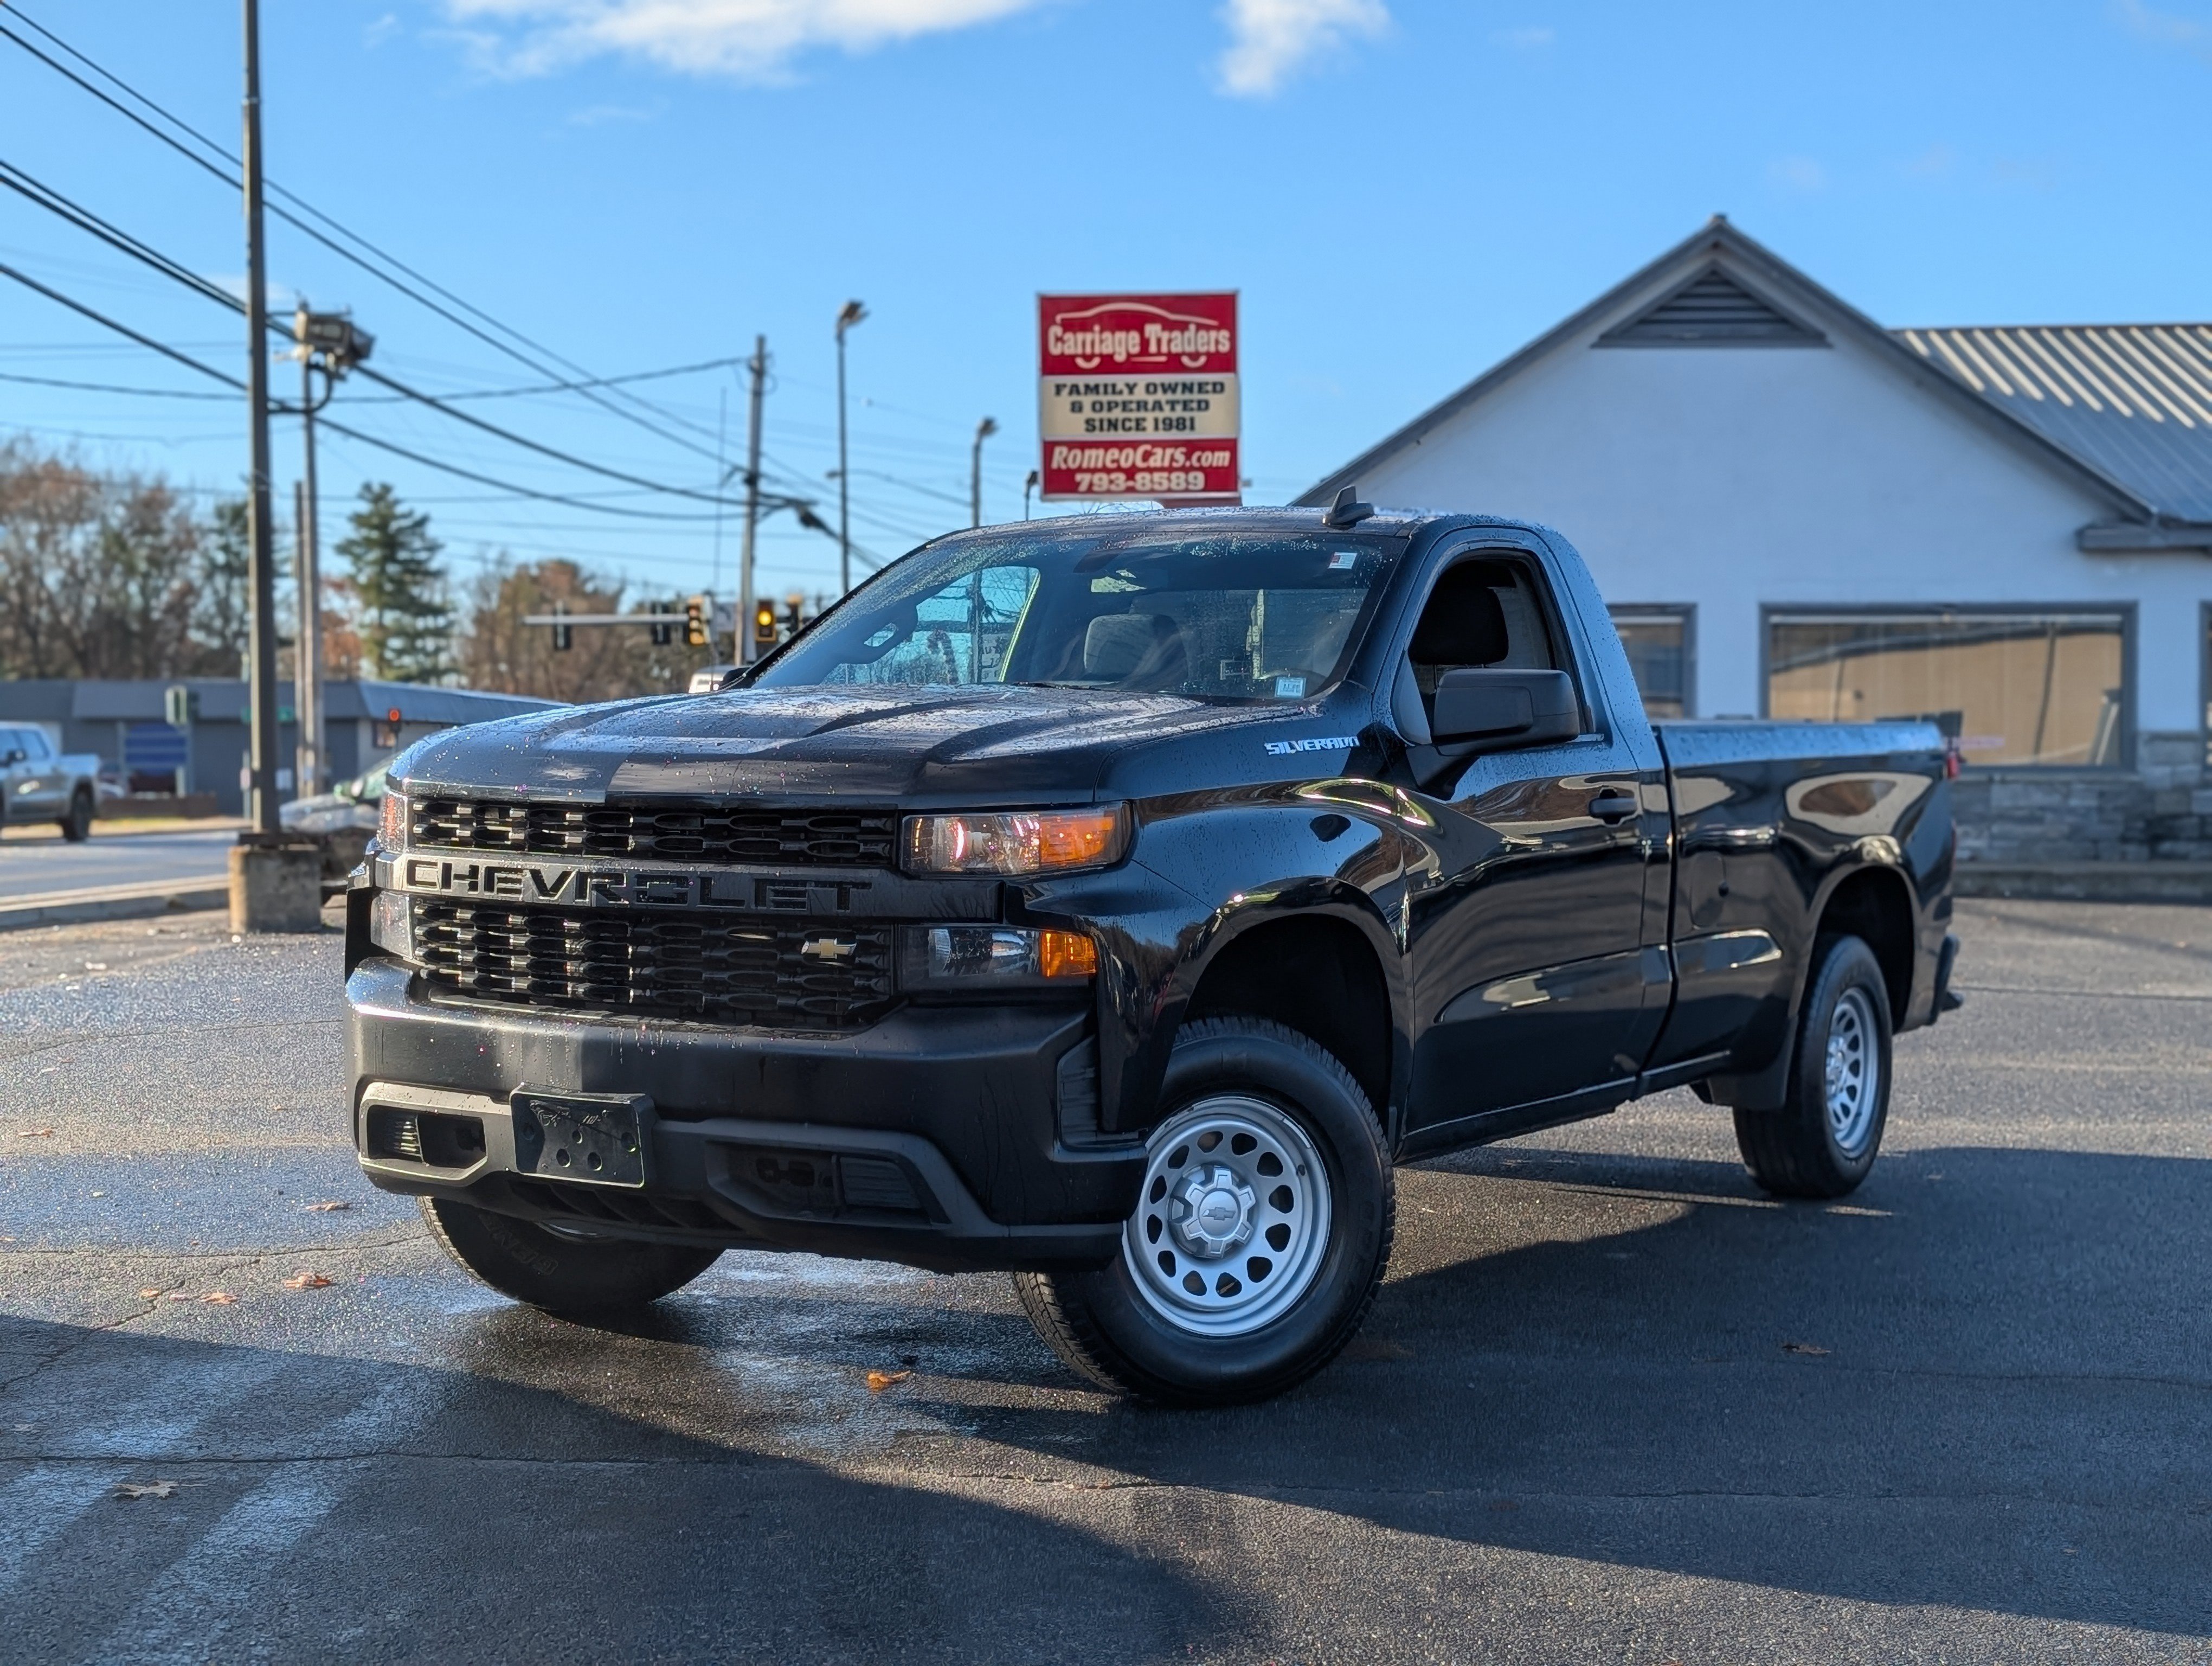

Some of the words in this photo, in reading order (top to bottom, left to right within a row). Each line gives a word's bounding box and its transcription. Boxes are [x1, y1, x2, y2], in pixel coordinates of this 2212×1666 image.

[1047, 324, 1140, 363] Carriage
[1144, 323, 1231, 354] Traders
[1054, 382, 1137, 396] FAMILY
[1144, 381, 1225, 395] OWNED
[1070, 401, 1083, 413] &
[1091, 399, 1210, 413] OPERATED
[1084, 417, 1147, 433] SINCE
[1153, 416, 1196, 432] 1981
[1051, 444, 1231, 470] RomeoCars.com
[1074, 471, 1206, 492] 793-8589
[1264, 735, 1360, 755] SILVERADO
[406, 858, 872, 912] CHEVROLET
